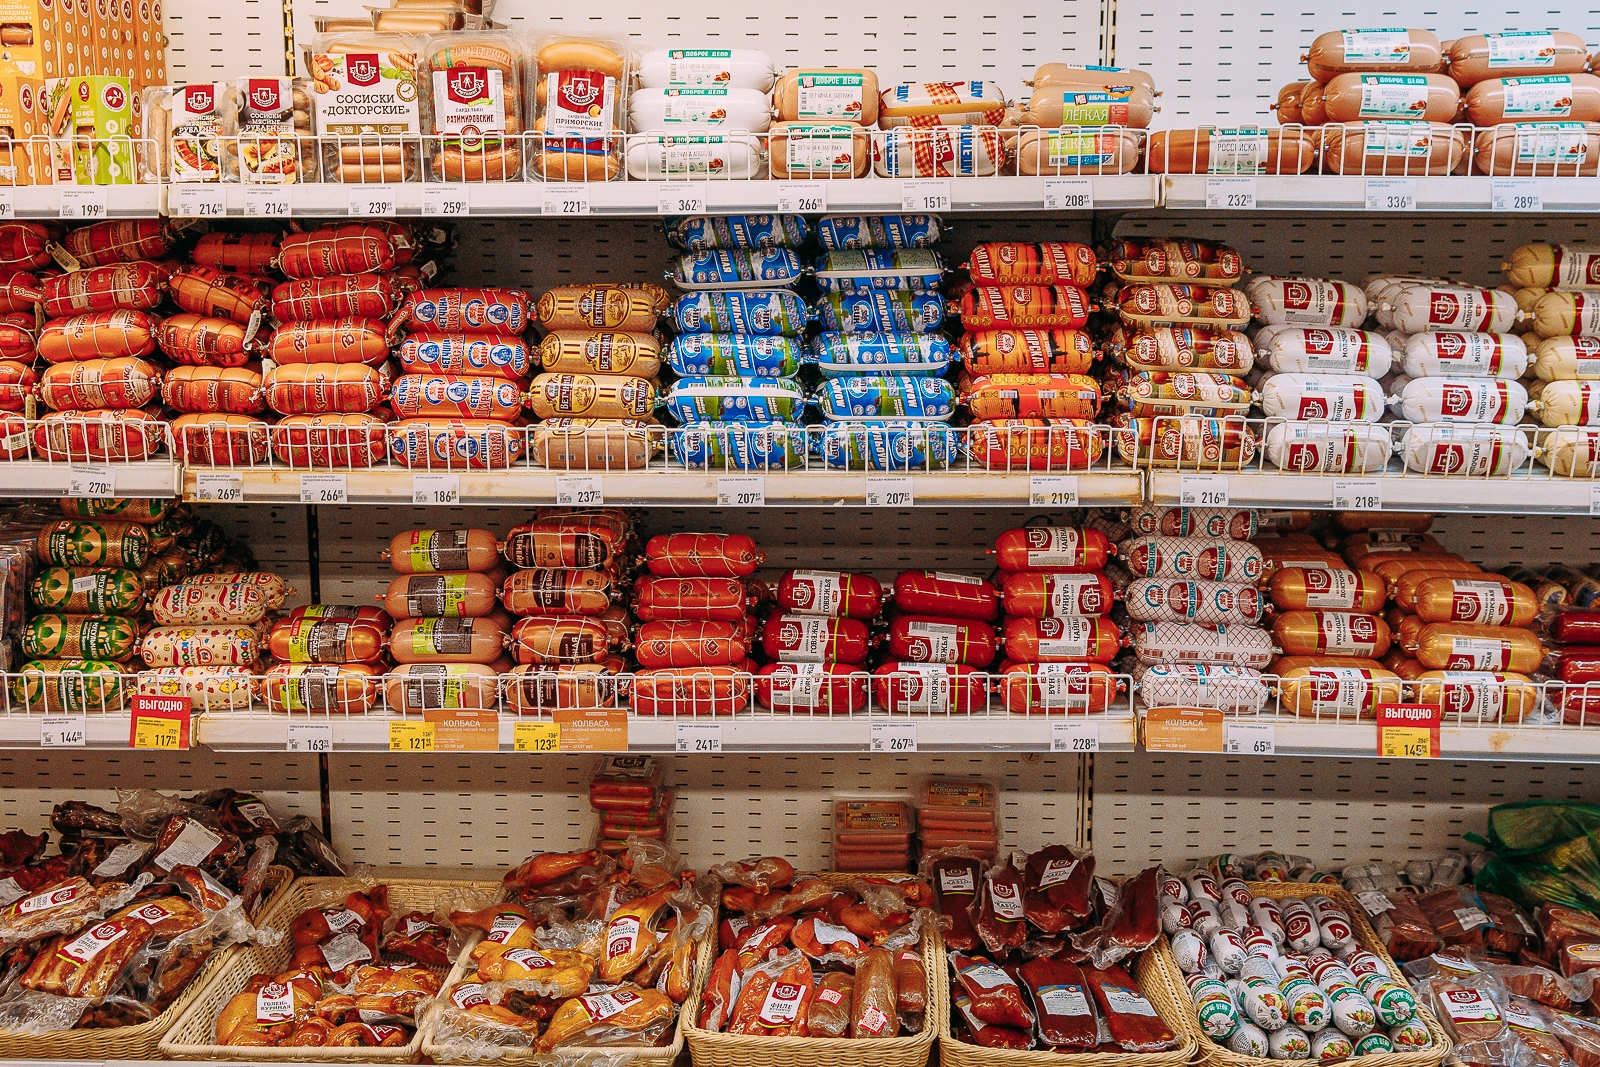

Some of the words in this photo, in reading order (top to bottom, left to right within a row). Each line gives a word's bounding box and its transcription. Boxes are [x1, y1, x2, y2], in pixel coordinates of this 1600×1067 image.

[336, 94, 395, 104] СОСИСКИ
[322, 106, 410, 116] «ДОКТОРСКИЕ»
[1064, 108, 1108, 122] ЛЁГКАЯ
[446, 114, 494, 124] РАТИМИРОВСКИЕ
[556, 118, 603, 127] ПРИМОРСКИЕ
[678, 200, 697, 211] 362
[799, 198, 818, 210] 266
[923, 196, 941, 208] 151
[1065, 194, 1084, 206] 208
[1228, 194, 1247, 206] 232
[1387, 196, 1406, 208] 336
[1514, 196, 1533, 208] 289
[81, 204, 99, 216] 199
[199, 204, 218, 215] 214
[265, 203, 284, 214] 214
[369, 202, 388, 214] 239
[443, 202, 461, 214] 259
[563, 201, 580, 214] 221
[594, 290, 604, 325] ВЕТЧИНА
[600, 334, 612, 370] ВЕТЧИНА
[1227, 343, 1236, 362] ВИК
[1187, 376, 1196, 394] ВИК
[88, 482, 106, 494] 270
[218, 488, 236, 502] 269
[320, 490, 340, 502] 266
[434, 490, 452, 502] 186
[578, 491, 596, 502] 237
[738, 493, 756, 504] 207
[886, 492, 905, 504] 207
[1052, 492, 1070, 504] 219
[1202, 492, 1220, 504] 216
[1356, 496, 1374, 508] 218
[172, 586, 183, 613] КРОХА
[229, 584, 240, 610] КРОХА
[823, 578, 831, 612] ГОВЯЖЬЯ
[811, 620, 820, 654] ГОВЯЖЬЯ
[140, 700, 182, 712] ВЫГОДНО
[1386, 708, 1432, 720] ВЫГОДНО
[60, 732, 78, 744] 144
[155, 734, 172, 746] 117
[409, 738, 426, 750] 121
[890, 738, 908, 750] 267
[1072, 738, 1091, 750] 228
[308, 739, 324, 751] 163
[534, 739, 552, 752] 123
[696, 739, 713, 751] 241
[1254, 740, 1266, 752] 65
